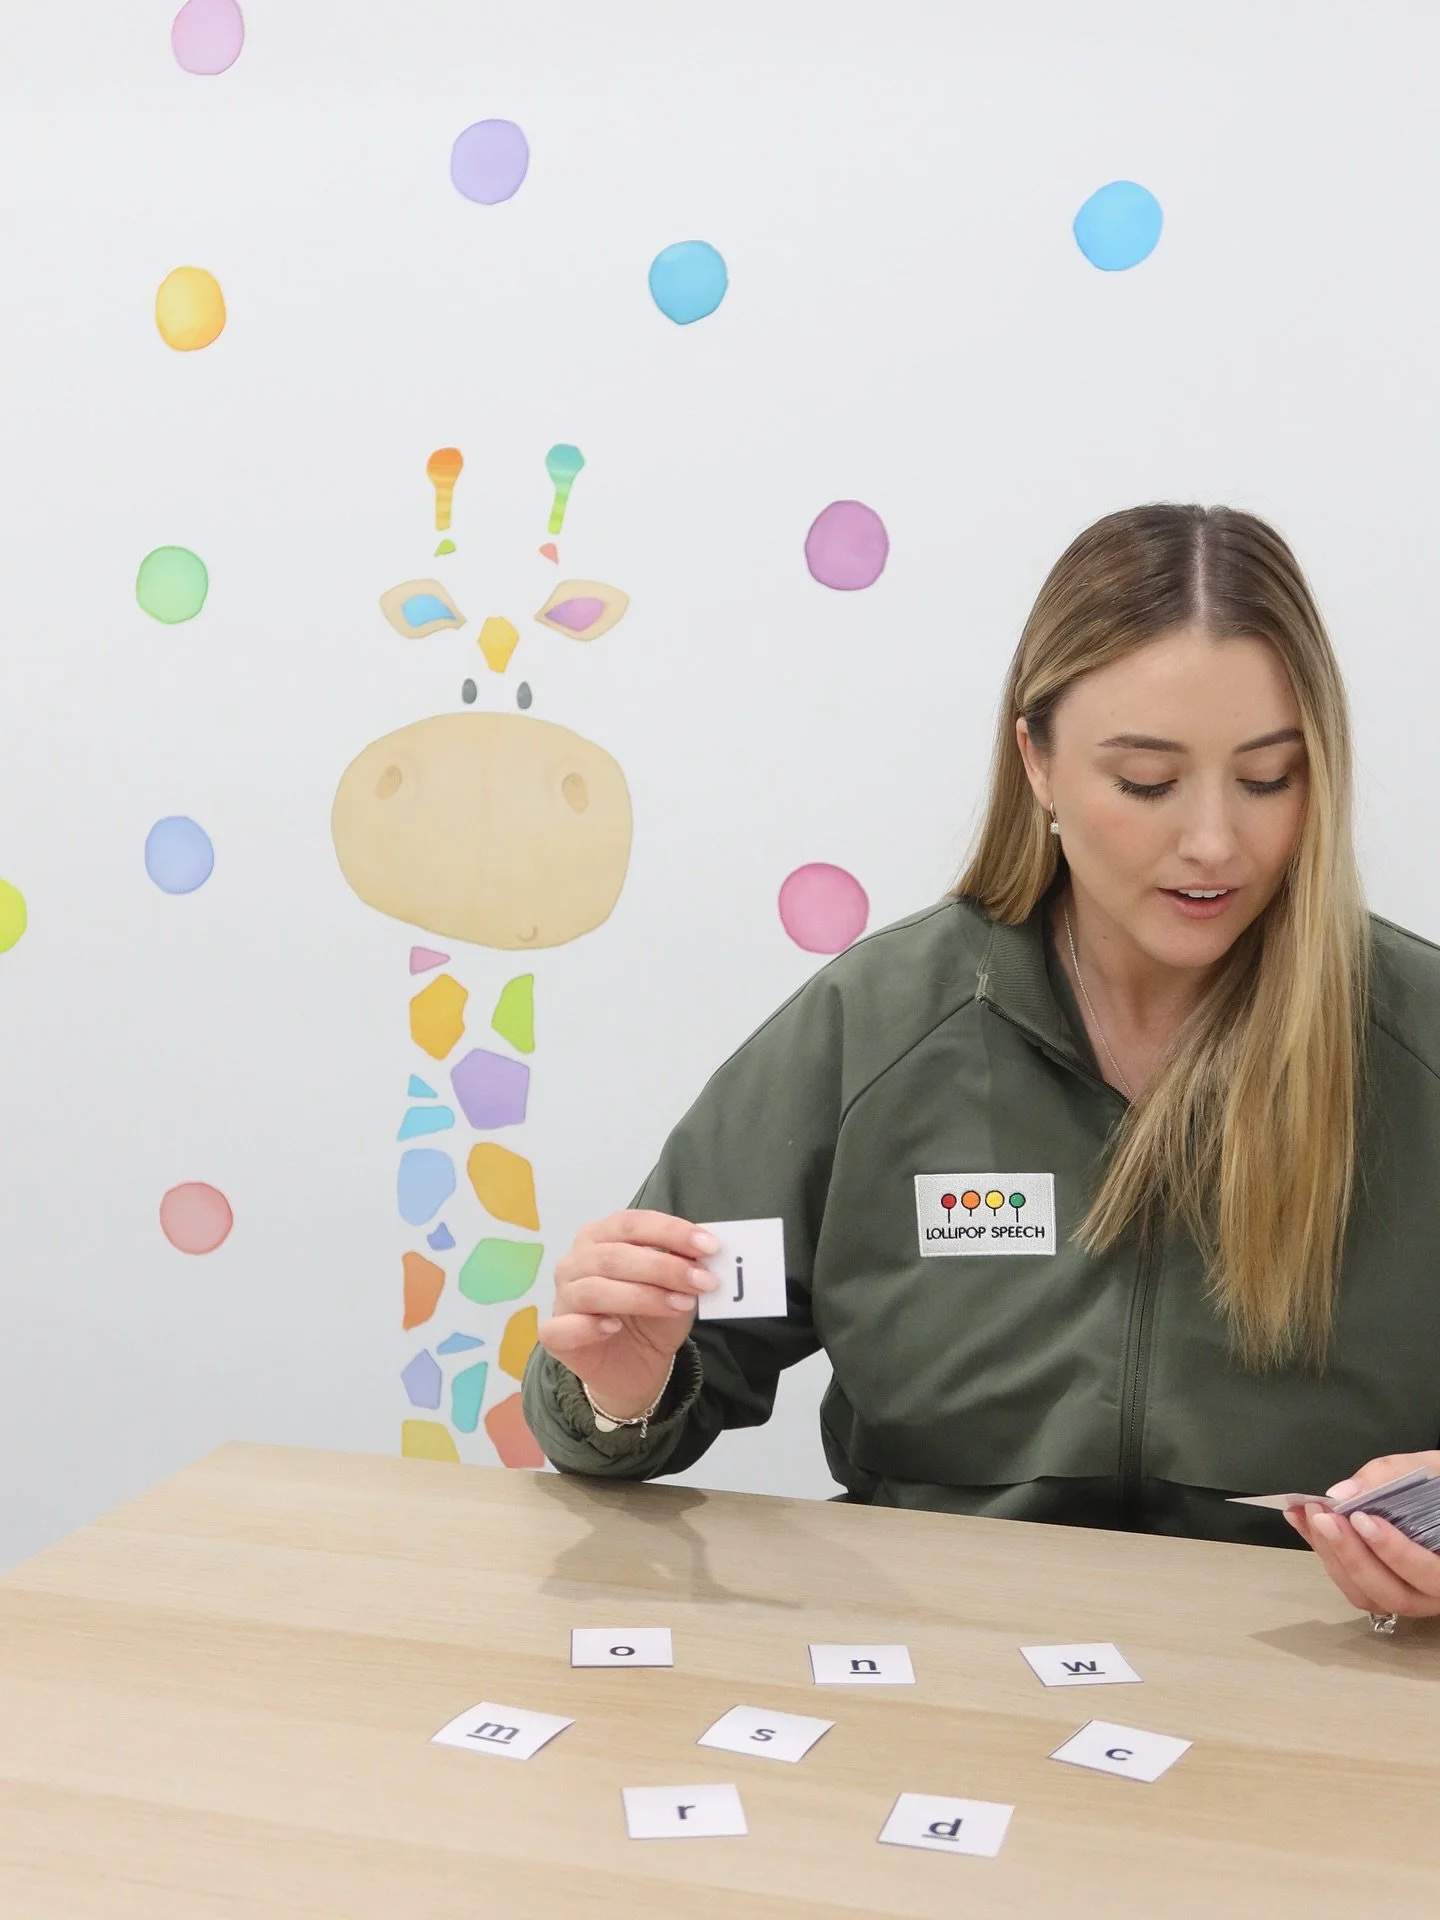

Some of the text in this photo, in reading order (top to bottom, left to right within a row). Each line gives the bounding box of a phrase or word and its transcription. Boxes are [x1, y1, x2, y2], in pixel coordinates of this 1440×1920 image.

[925, 1225, 1046, 1241] LOLLIPOP SPEECH
[732, 1256, 745, 1303] j
[609, 1645, 636, 1658] o
[850, 1658, 879, 1672] n
[1060, 1659, 1099, 1674] w
[474, 1720, 519, 1742] m
[750, 1726, 776, 1742] s
[1105, 1746, 1134, 1762] c
[676, 1803, 695, 1821] r
[927, 1817, 963, 1837] d
